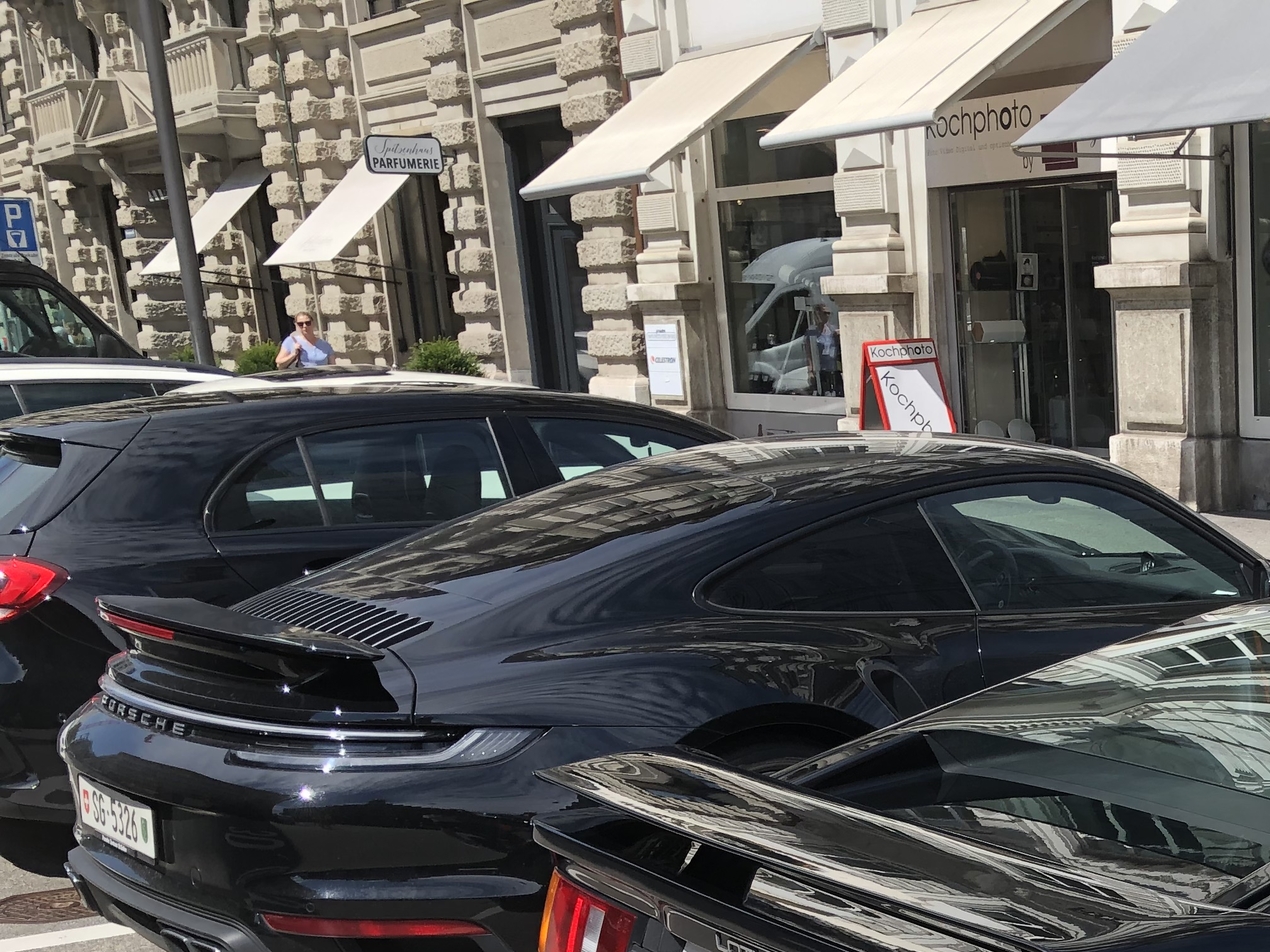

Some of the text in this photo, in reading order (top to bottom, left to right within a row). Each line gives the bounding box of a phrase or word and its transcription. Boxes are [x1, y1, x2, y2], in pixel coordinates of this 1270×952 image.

[372, 157, 440, 169] PARFUMERIE
[4, 203, 22, 228] P
[870, 344, 933, 358] Kochphoto
[101, 694, 186, 736] PORSCHE
